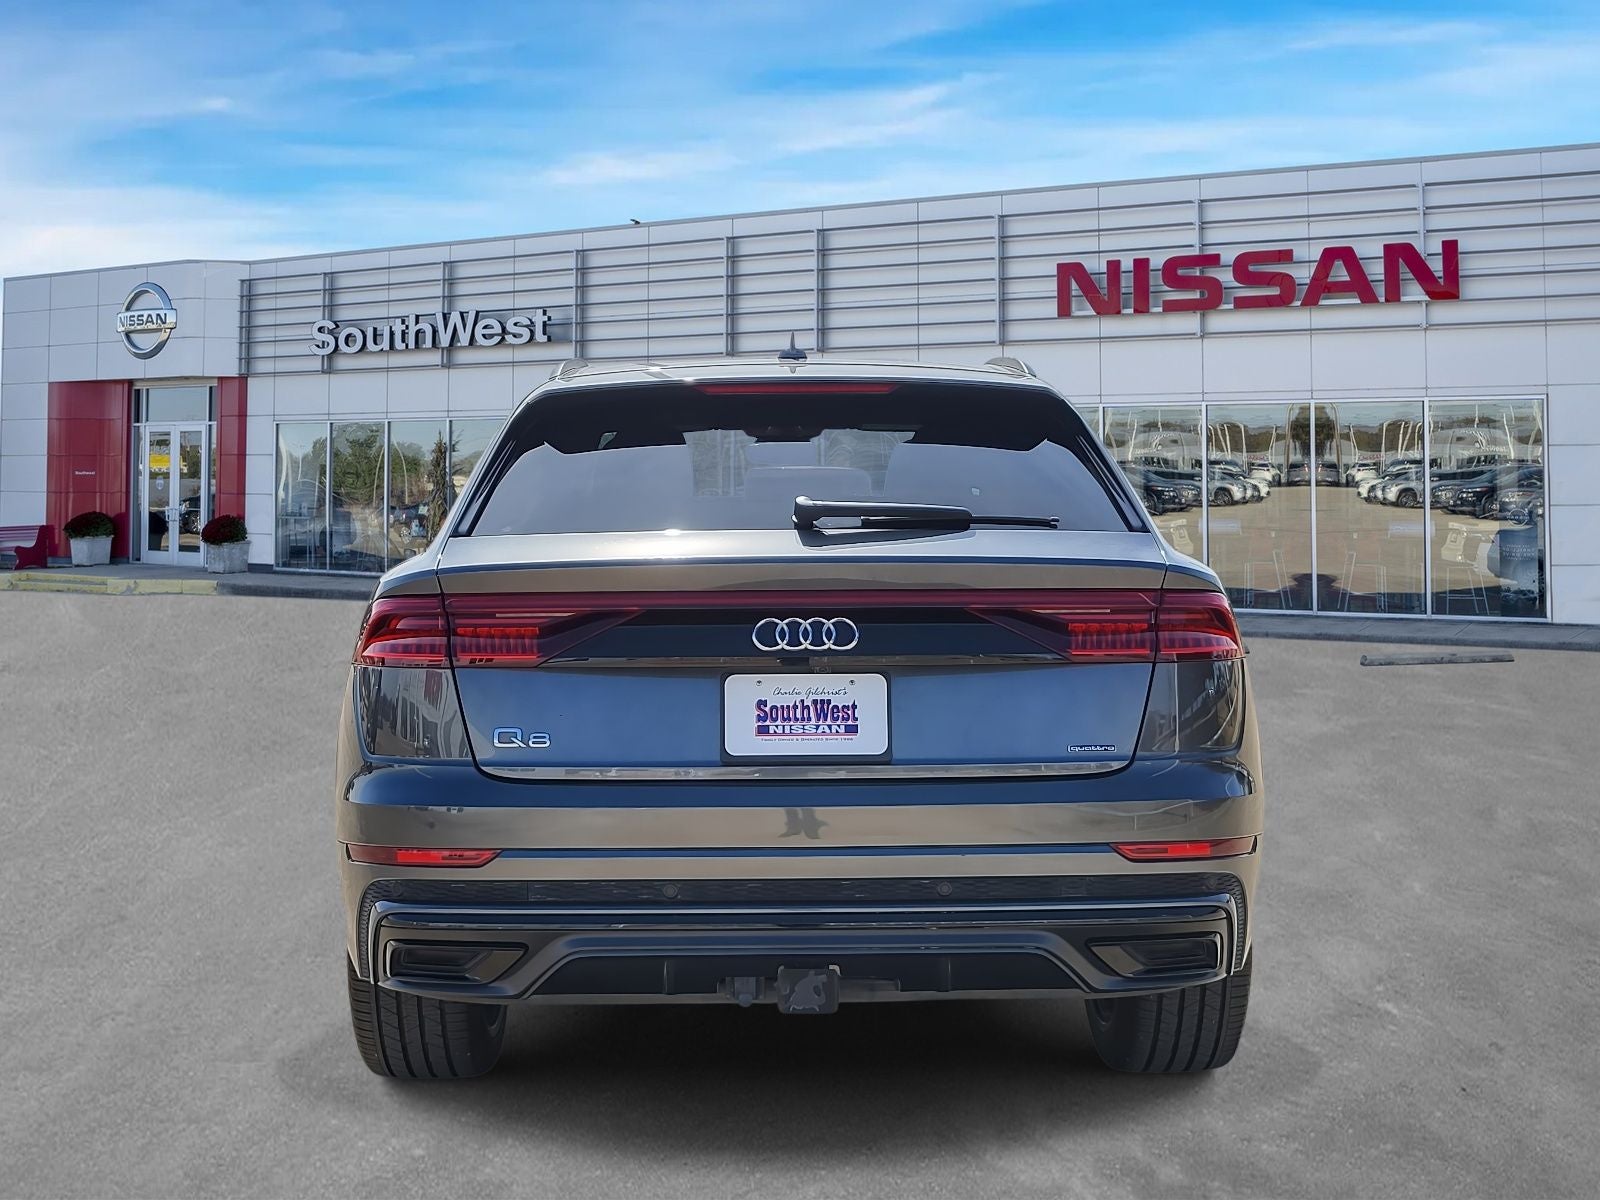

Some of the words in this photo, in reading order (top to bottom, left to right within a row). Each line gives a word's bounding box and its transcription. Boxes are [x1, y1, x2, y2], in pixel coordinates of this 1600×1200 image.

[1056, 239, 1461, 318] NISSAN
[119, 312, 168, 327] NISSAN
[309, 308, 552, 355] SouthWest
[772, 687, 802, 696] Charlie
[804, 687, 848, 699] Gilchrist's
[755, 699, 858, 723] SouthWest
[493, 727, 551, 748] Q8
[768, 725, 846, 734] NISSAN
